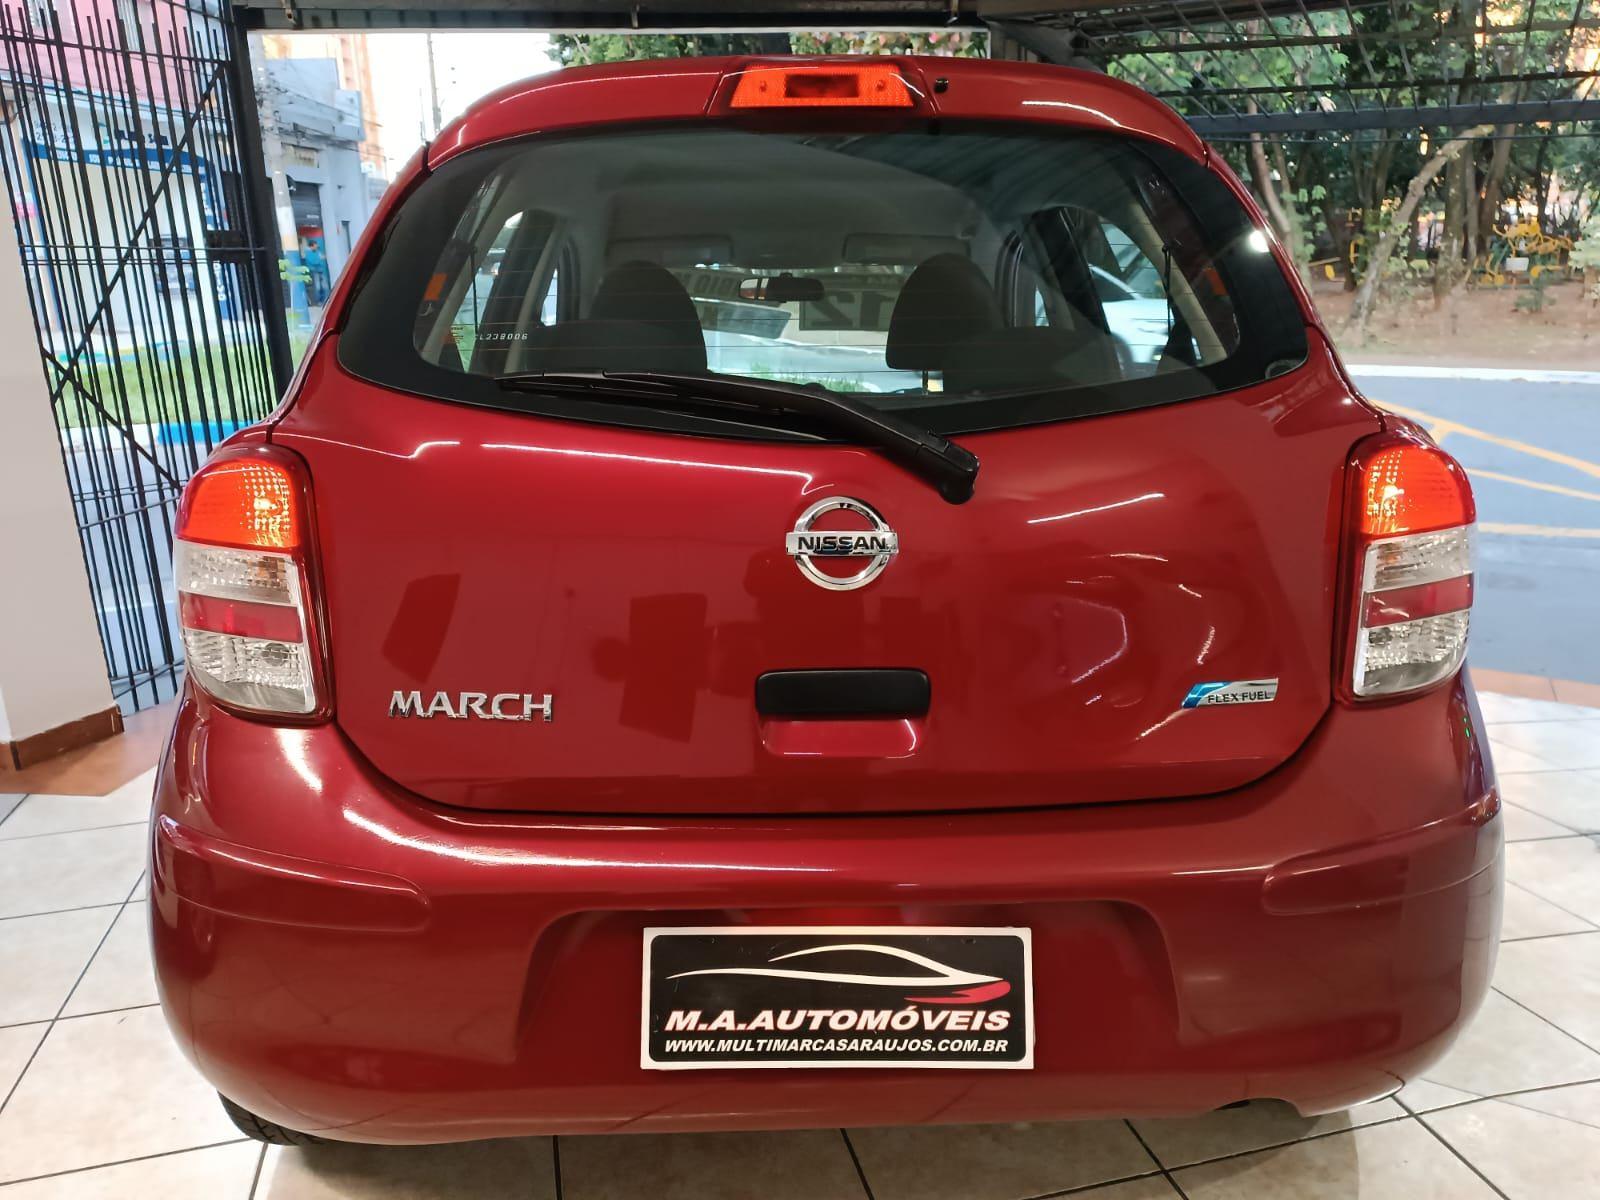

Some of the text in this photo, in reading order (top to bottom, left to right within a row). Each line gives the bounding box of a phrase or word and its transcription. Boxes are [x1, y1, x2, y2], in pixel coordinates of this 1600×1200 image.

[797, 536, 887, 550] NISSAN
[1207, 691, 1270, 703] FLEX FUEL
[388, 690, 552, 722] MARCH
[664, 1006, 1012, 1032] M.A.AUTOMÓVEIS
[664, 1038, 1009, 1054] WWW.MULTIMARCASARAUJOS.COM.BR
